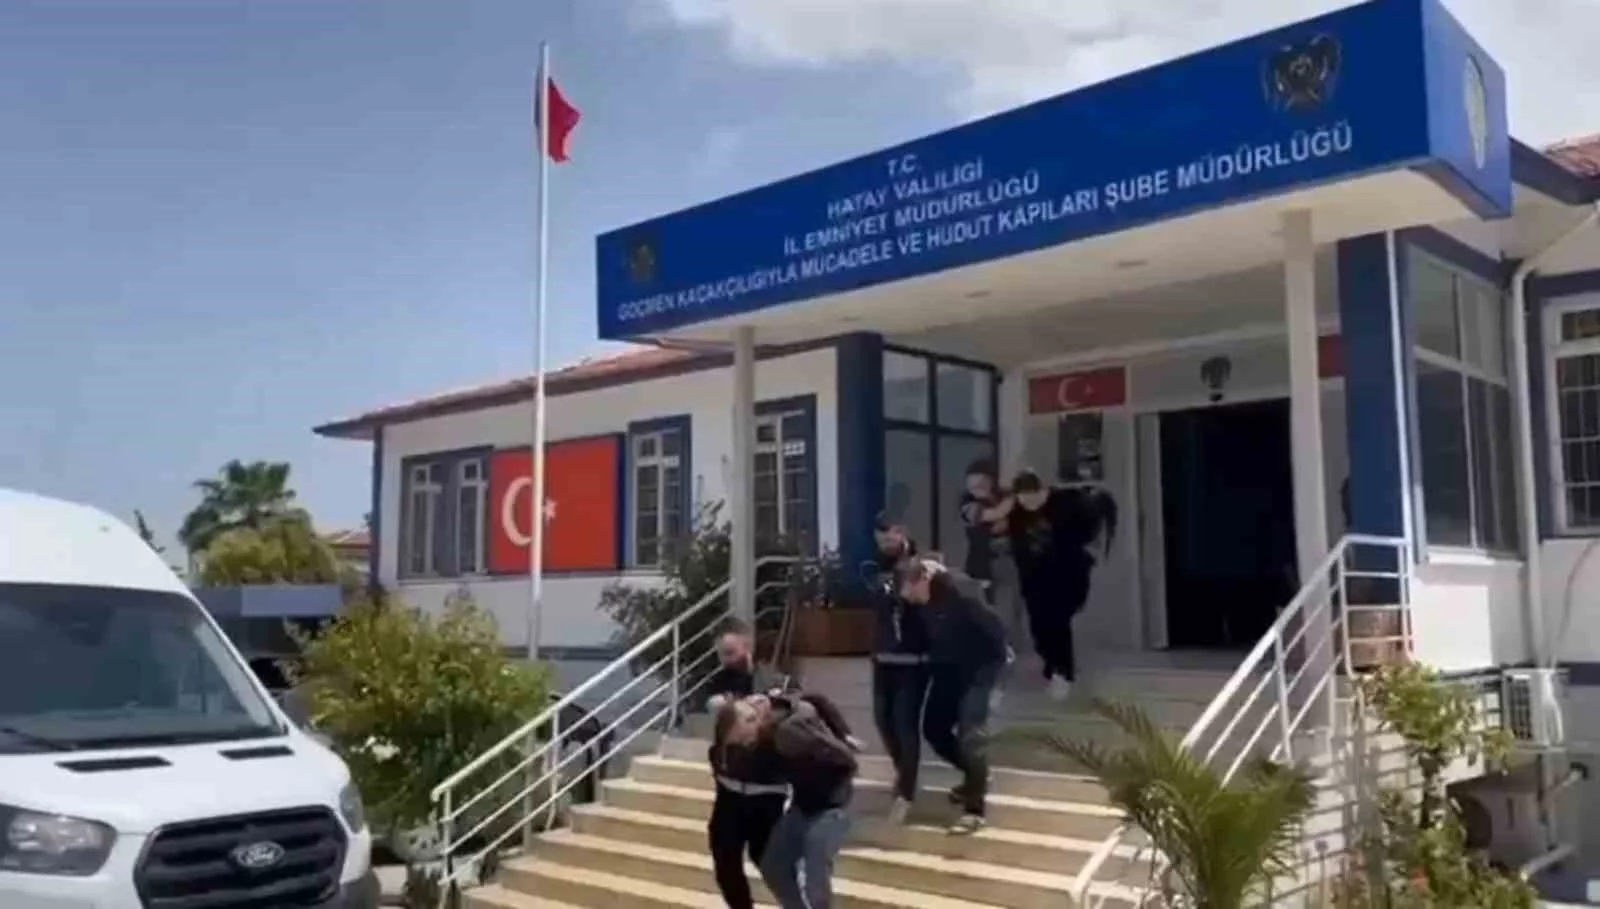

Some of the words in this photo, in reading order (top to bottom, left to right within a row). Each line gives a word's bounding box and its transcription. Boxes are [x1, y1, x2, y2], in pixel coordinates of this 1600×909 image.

[827, 186, 888, 219] HATAY
[897, 231, 922, 255] VE
[998, 187, 1099, 234] KAPILARI
[1103, 169, 1170, 209] ŞUBE
[1176, 119, 1353, 190] MÜDÜRLÜĞÜ
